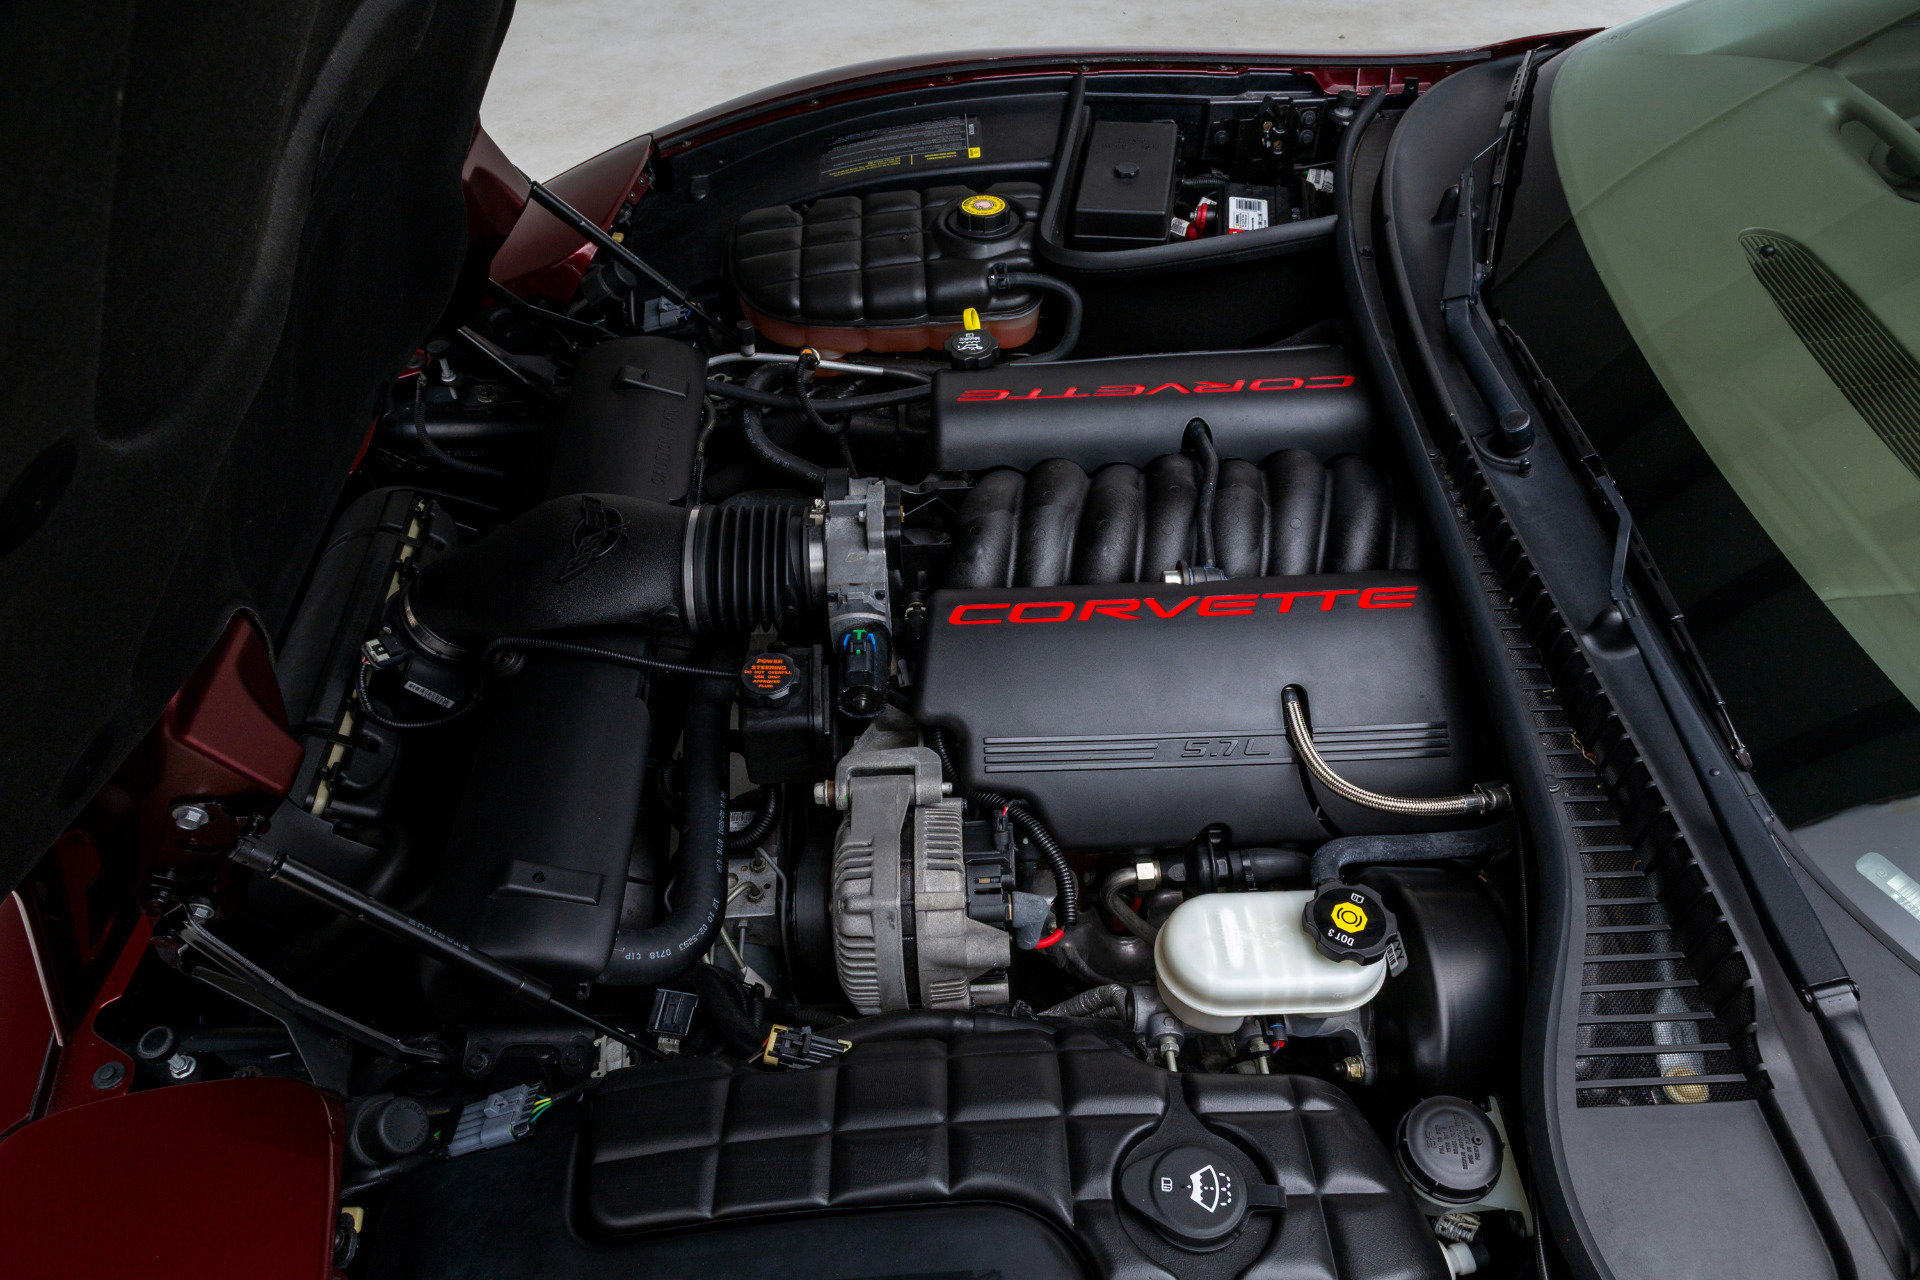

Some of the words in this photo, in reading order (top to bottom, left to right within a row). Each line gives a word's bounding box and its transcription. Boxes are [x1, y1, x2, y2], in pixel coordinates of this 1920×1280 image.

[957, 376, 1354, 401] CORVETTE
[948, 587, 1418, 625] CORVETTE
[1181, 738, 1272, 758] 5.7L
[408, 918, 470, 952] STABILUS
[678, 924, 708, 951] 02-5293
[1327, 928, 1335, 937] 3
[1334, 932, 1355, 947] DOT
[624, 952, 642, 960] CIP
[649, 948, 671, 960] 0718
